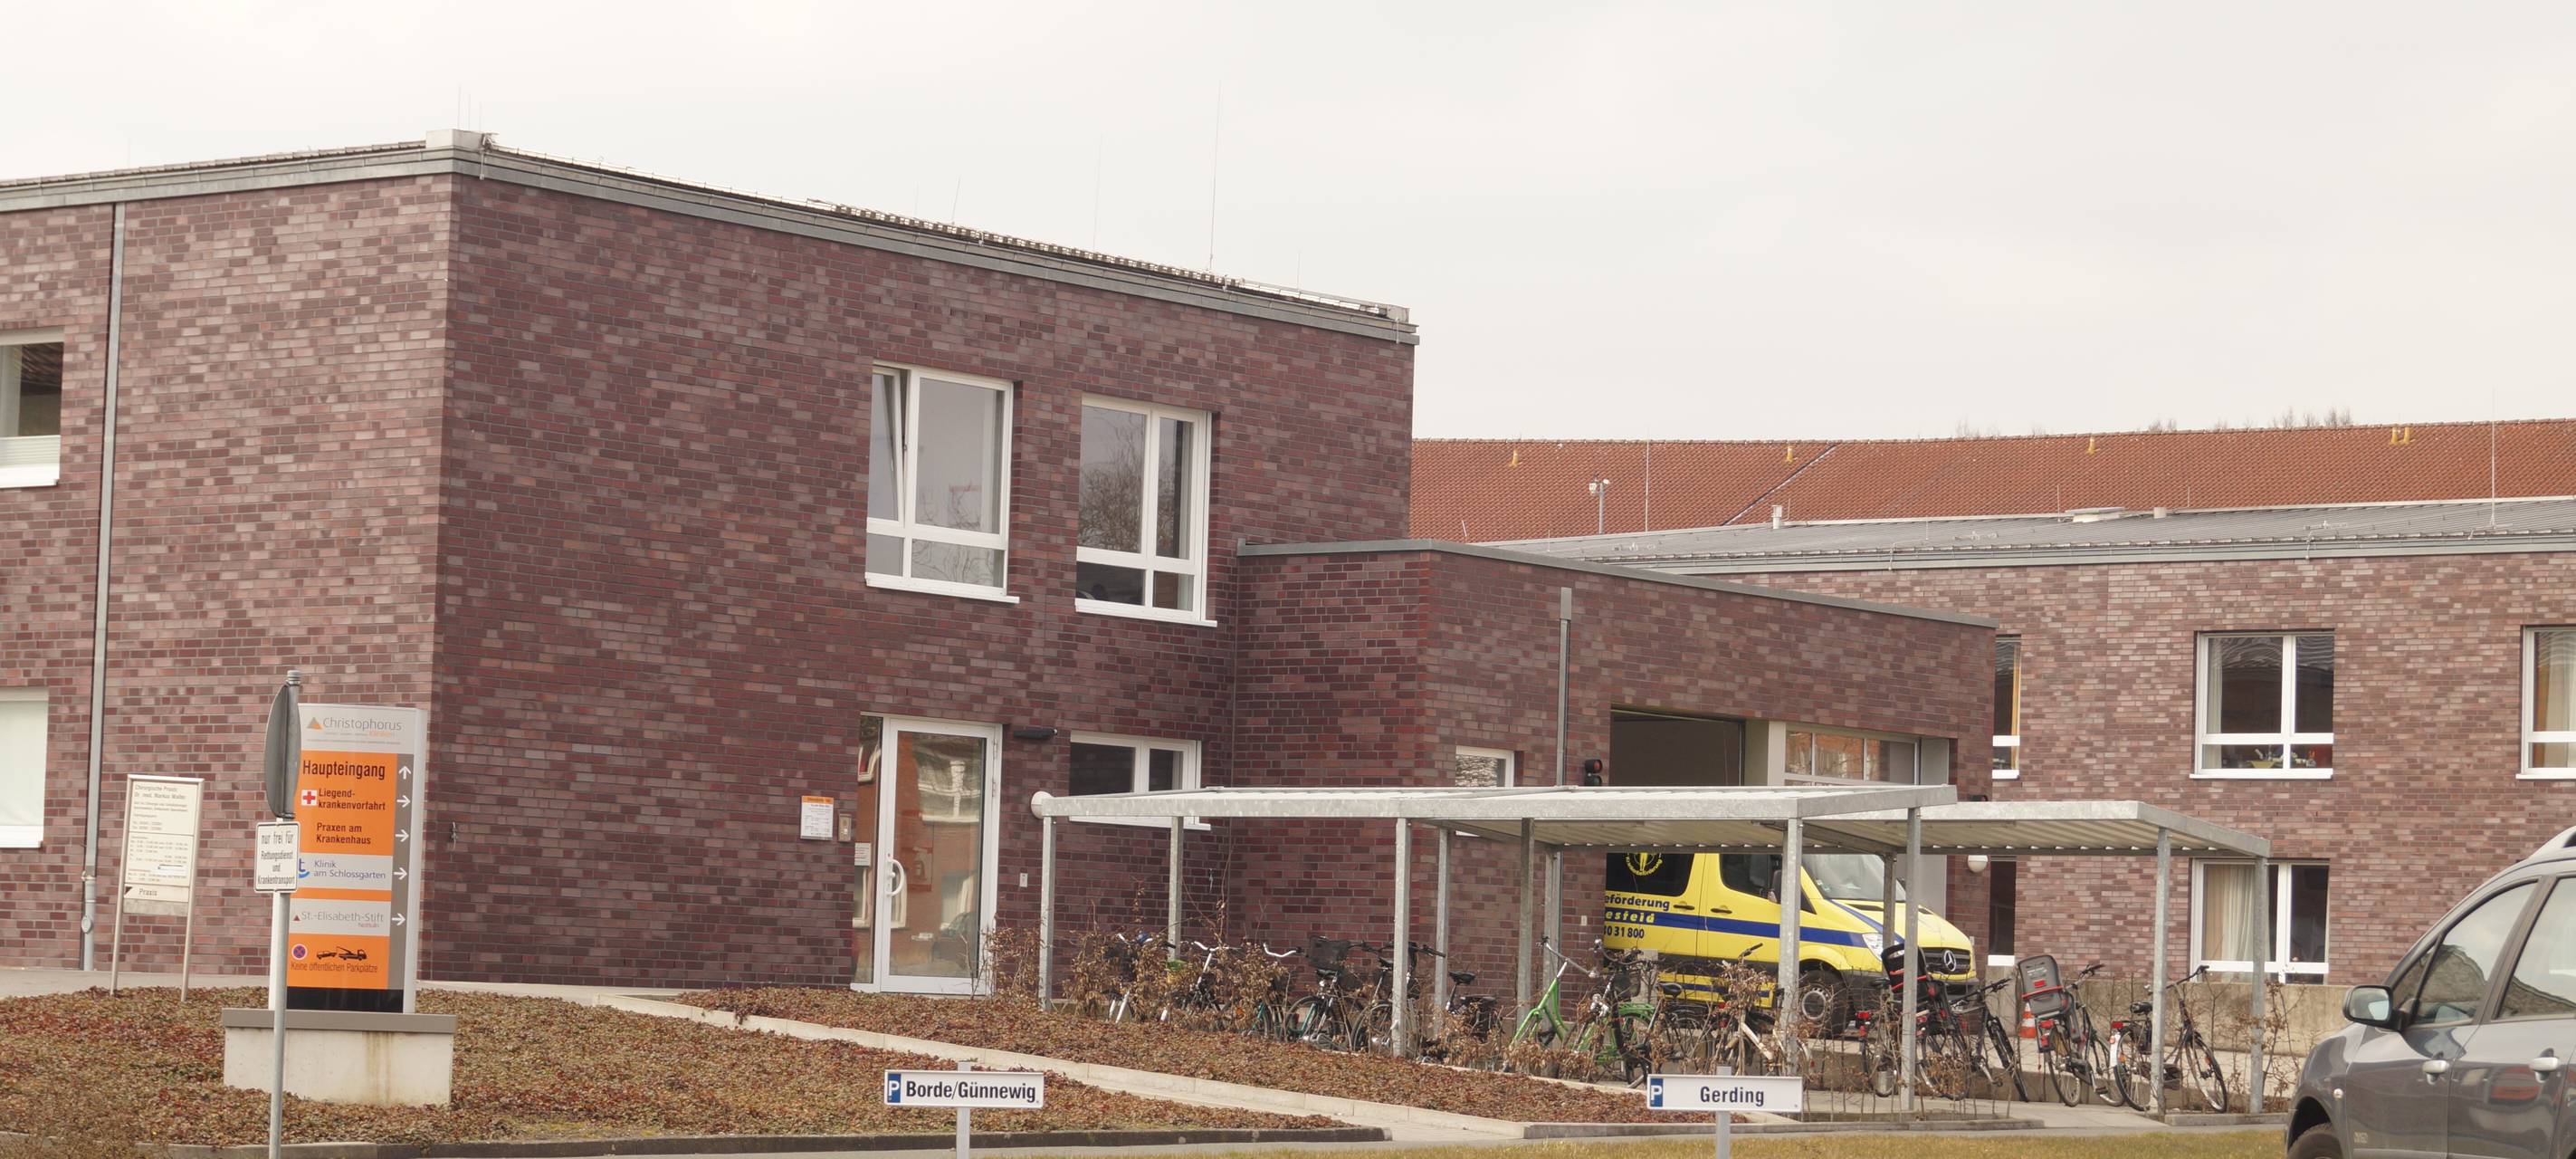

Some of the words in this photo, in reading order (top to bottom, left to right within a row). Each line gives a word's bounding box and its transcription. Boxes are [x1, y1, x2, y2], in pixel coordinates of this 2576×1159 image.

[323, 717, 402, 731] Christophorus
[302, 760, 386, 781] Haupteingang
[319, 788, 355, 799] Liegend-
[318, 800, 386, 811] krankenvorfahrt
[317, 822, 346, 833] Praxen
[348, 825, 362, 833] am
[262, 835, 271, 845] nur
[273, 831, 283, 845] frei
[316, 834, 371, 845] Krankenhaus
[272, 863, 281, 872] und
[314, 859, 337, 869] Klinik
[329, 868, 386, 881] Schlossgarten
[258, 875, 295, 886] Krankentransport
[301, 911, 384, 923] St.-Elisabeth-Stift
[291, 963, 309, 972] Keine
[346, 963, 378, 974] Parkplätze
[889, 1080, 900, 1097] P
[906, 1080, 1036, 1104] Borde/Günnewig
[1650, 1085, 1663, 1101] P
[1700, 1086, 1765, 1107] Gerding
